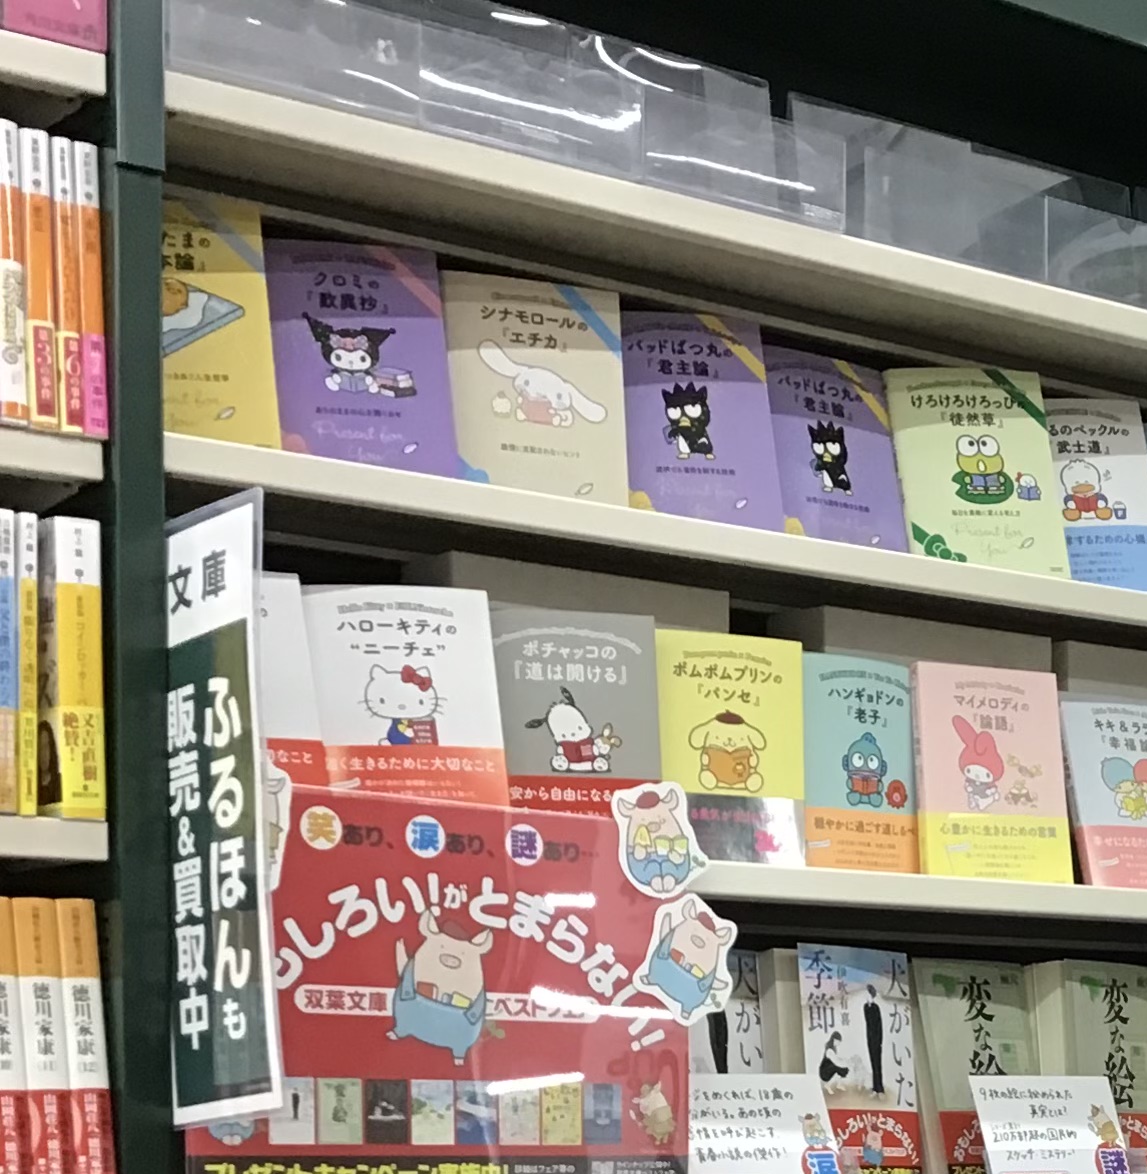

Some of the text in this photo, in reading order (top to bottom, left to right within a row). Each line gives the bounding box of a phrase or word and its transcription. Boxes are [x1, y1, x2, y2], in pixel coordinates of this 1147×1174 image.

[313, 271, 380, 290] クロミの
[480, 304, 589, 332] シナモロールの
[500, 328, 569, 353] 『エチカ』
[627, 338, 734, 360] バッドばつ丸の
[168, 550, 227, 615] 文庫
[337, 618, 457, 635] ハローキティの
[522, 641, 617, 660] ポチャッコの
[672, 661, 783, 686] ポムポムプリンの
[953, 693, 1030, 712] マイメロディの
[167, 683, 209, 1050] 販売&買取中
[204, 676, 251, 1040] ふるほんも
[304, 987, 388, 1012] 双葉文庫
